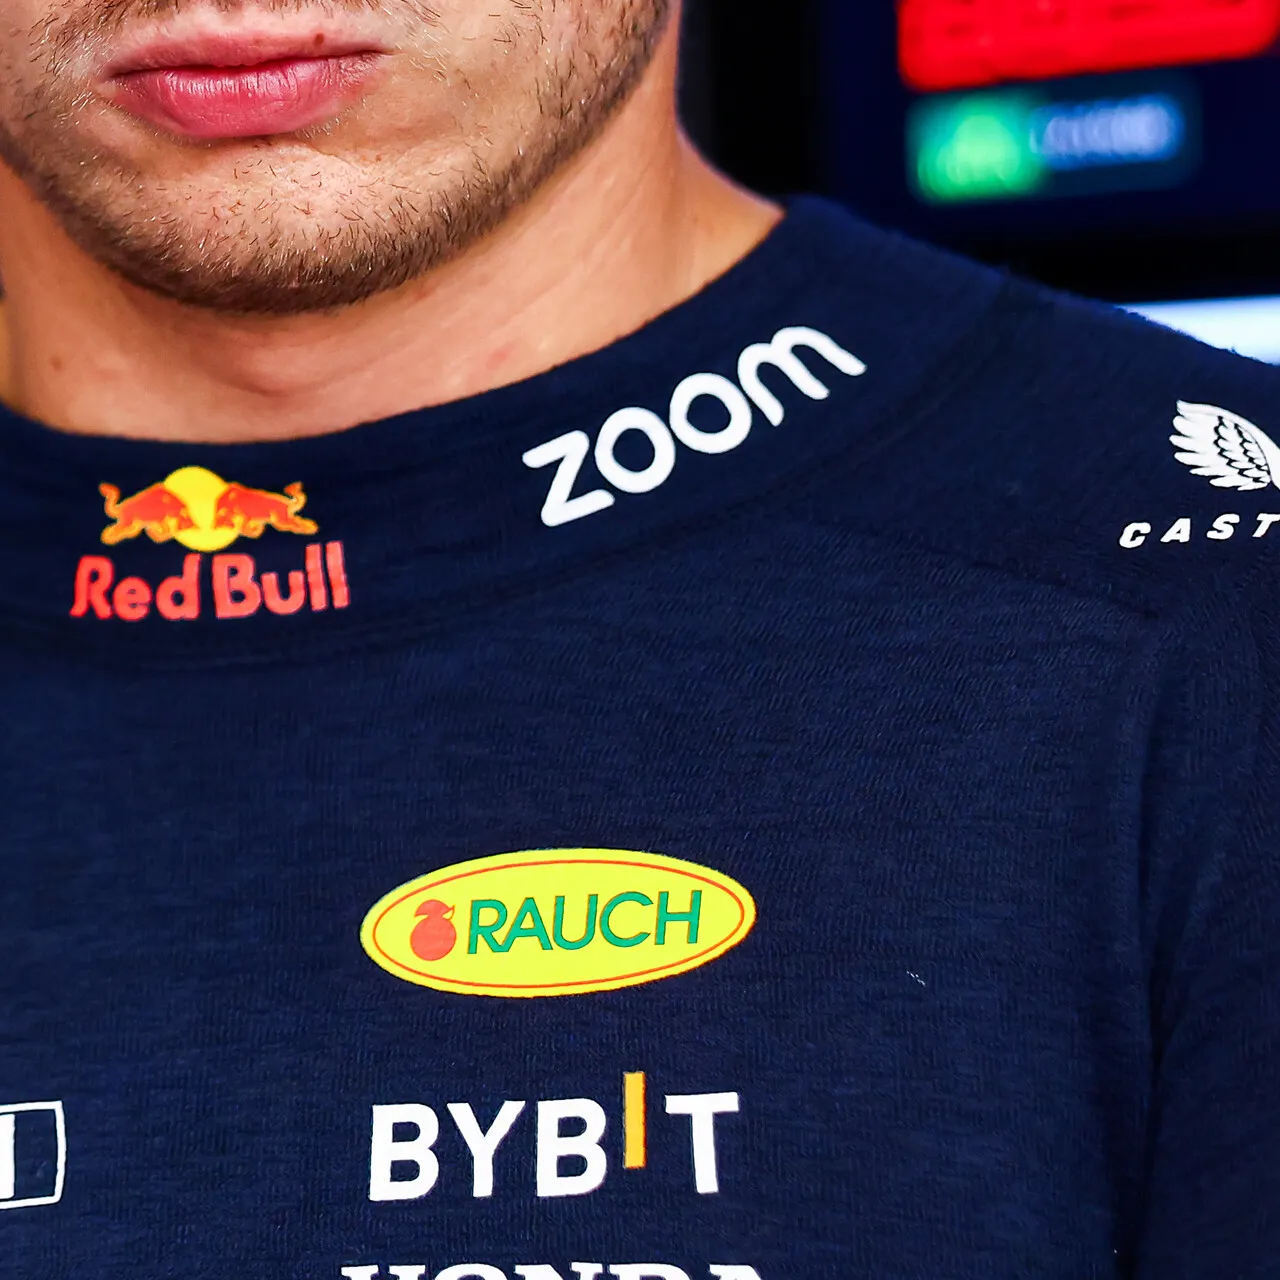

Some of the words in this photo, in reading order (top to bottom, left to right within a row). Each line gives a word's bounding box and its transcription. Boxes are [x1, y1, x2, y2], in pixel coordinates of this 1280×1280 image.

[522, 326, 867, 527] zoom
[70, 553, 202, 621] Red
[212, 541, 350, 619] Bull
[467, 890, 702, 955] RAUCH
[369, 1071, 739, 1202] BYBIT
